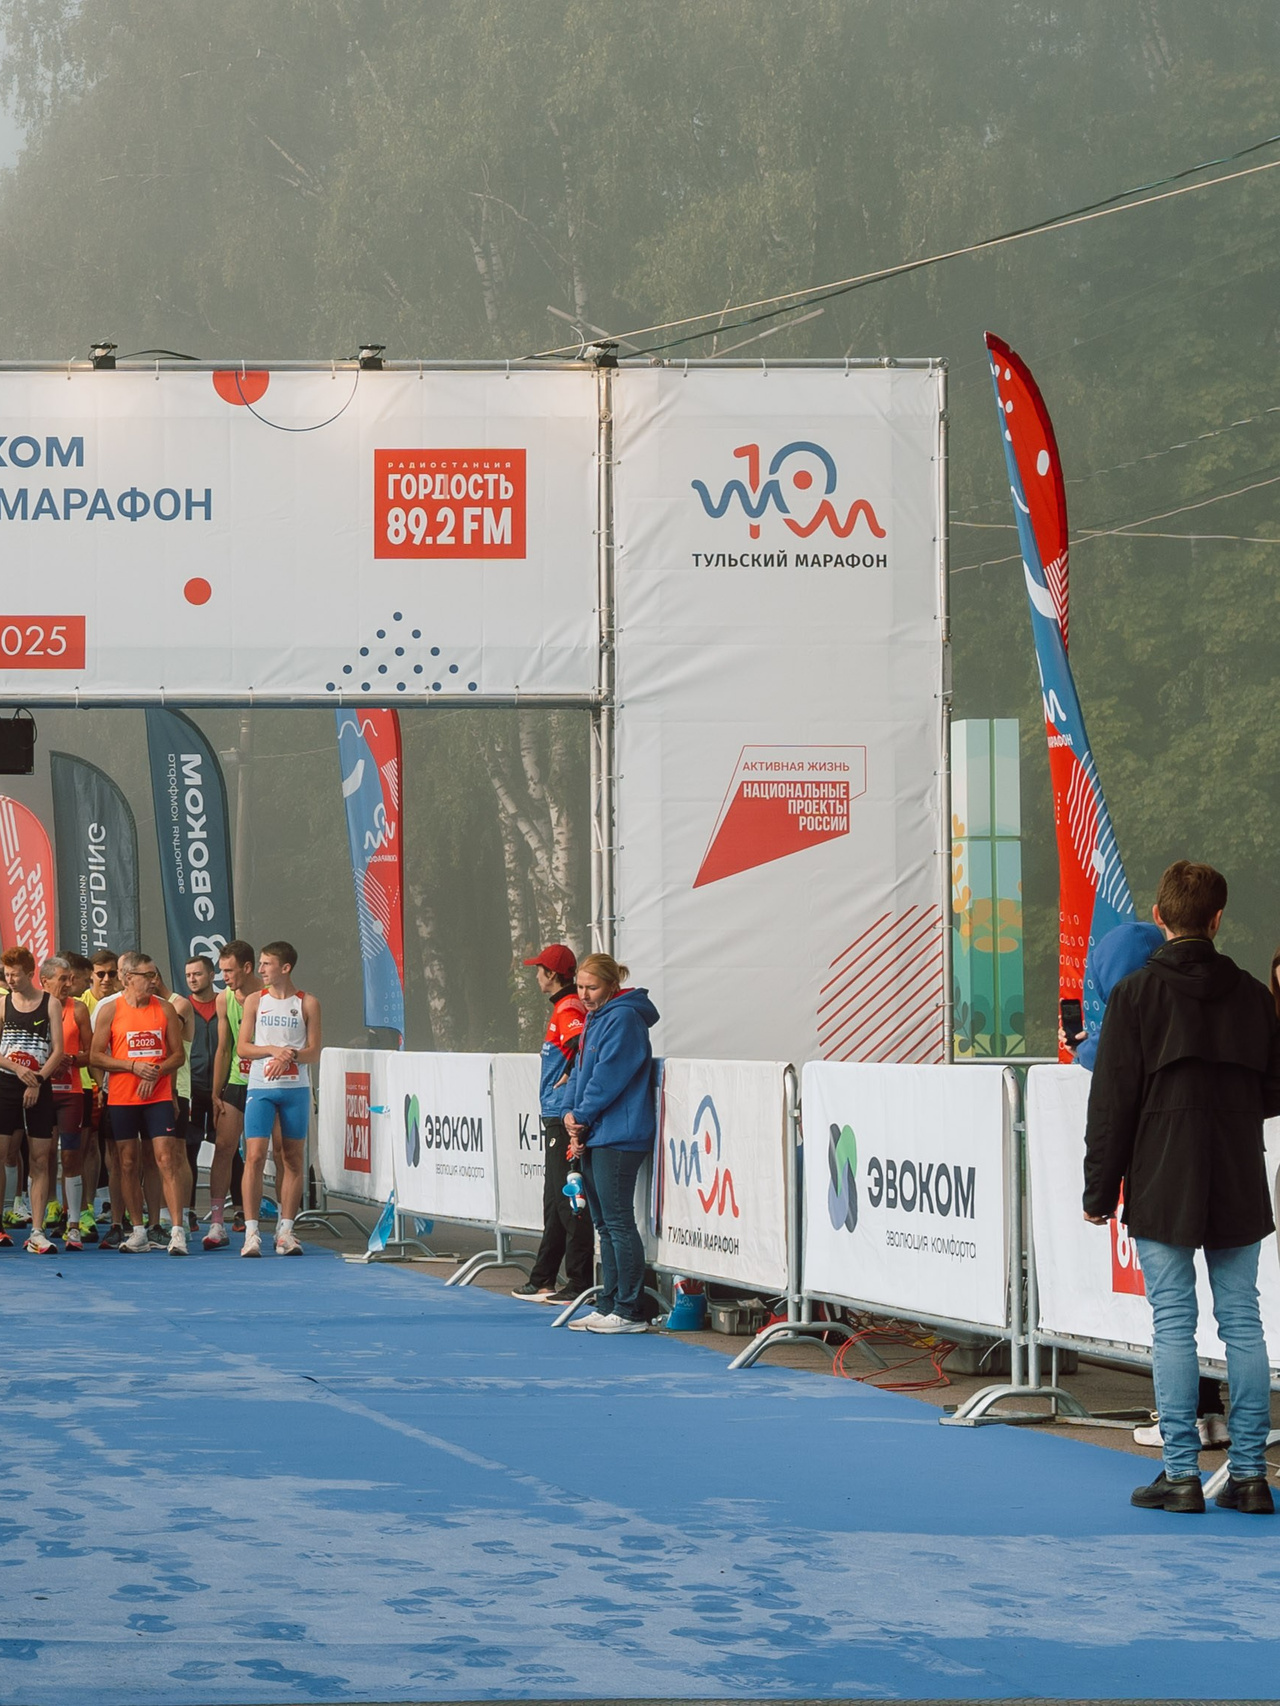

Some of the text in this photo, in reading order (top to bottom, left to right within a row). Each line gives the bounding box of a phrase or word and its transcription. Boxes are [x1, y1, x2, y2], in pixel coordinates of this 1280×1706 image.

[387, 461, 512, 469] РАДИОСТАНЦИЯ
[387, 473, 514, 500] ГОРДОСТЬ
[386, 506, 512, 546] 89.2 FM
[692, 549, 888, 569] ТУЛЬСКИЙ МАРАФОН
[742, 761, 850, 772] АКТИВНАЯ ЖИЗНЬ
[742, 782, 848, 800] НАЦИОНАЛЬНЫЕ
[787, 799, 848, 815] ПРОЕКТЫ
[798, 815, 848, 831] РОССИИ
[260, 1015, 299, 1029] RUSSIA
[135, 1038, 156, 1048] 2028
[424, 1114, 484, 1152] ЭВОКОМ
[866, 1156, 977, 1220] ЭВОКОМ
[667, 1226, 703, 1249] ТУЛЬСКИЙ
[886, 1229, 977, 1263] эволюция комфорта
